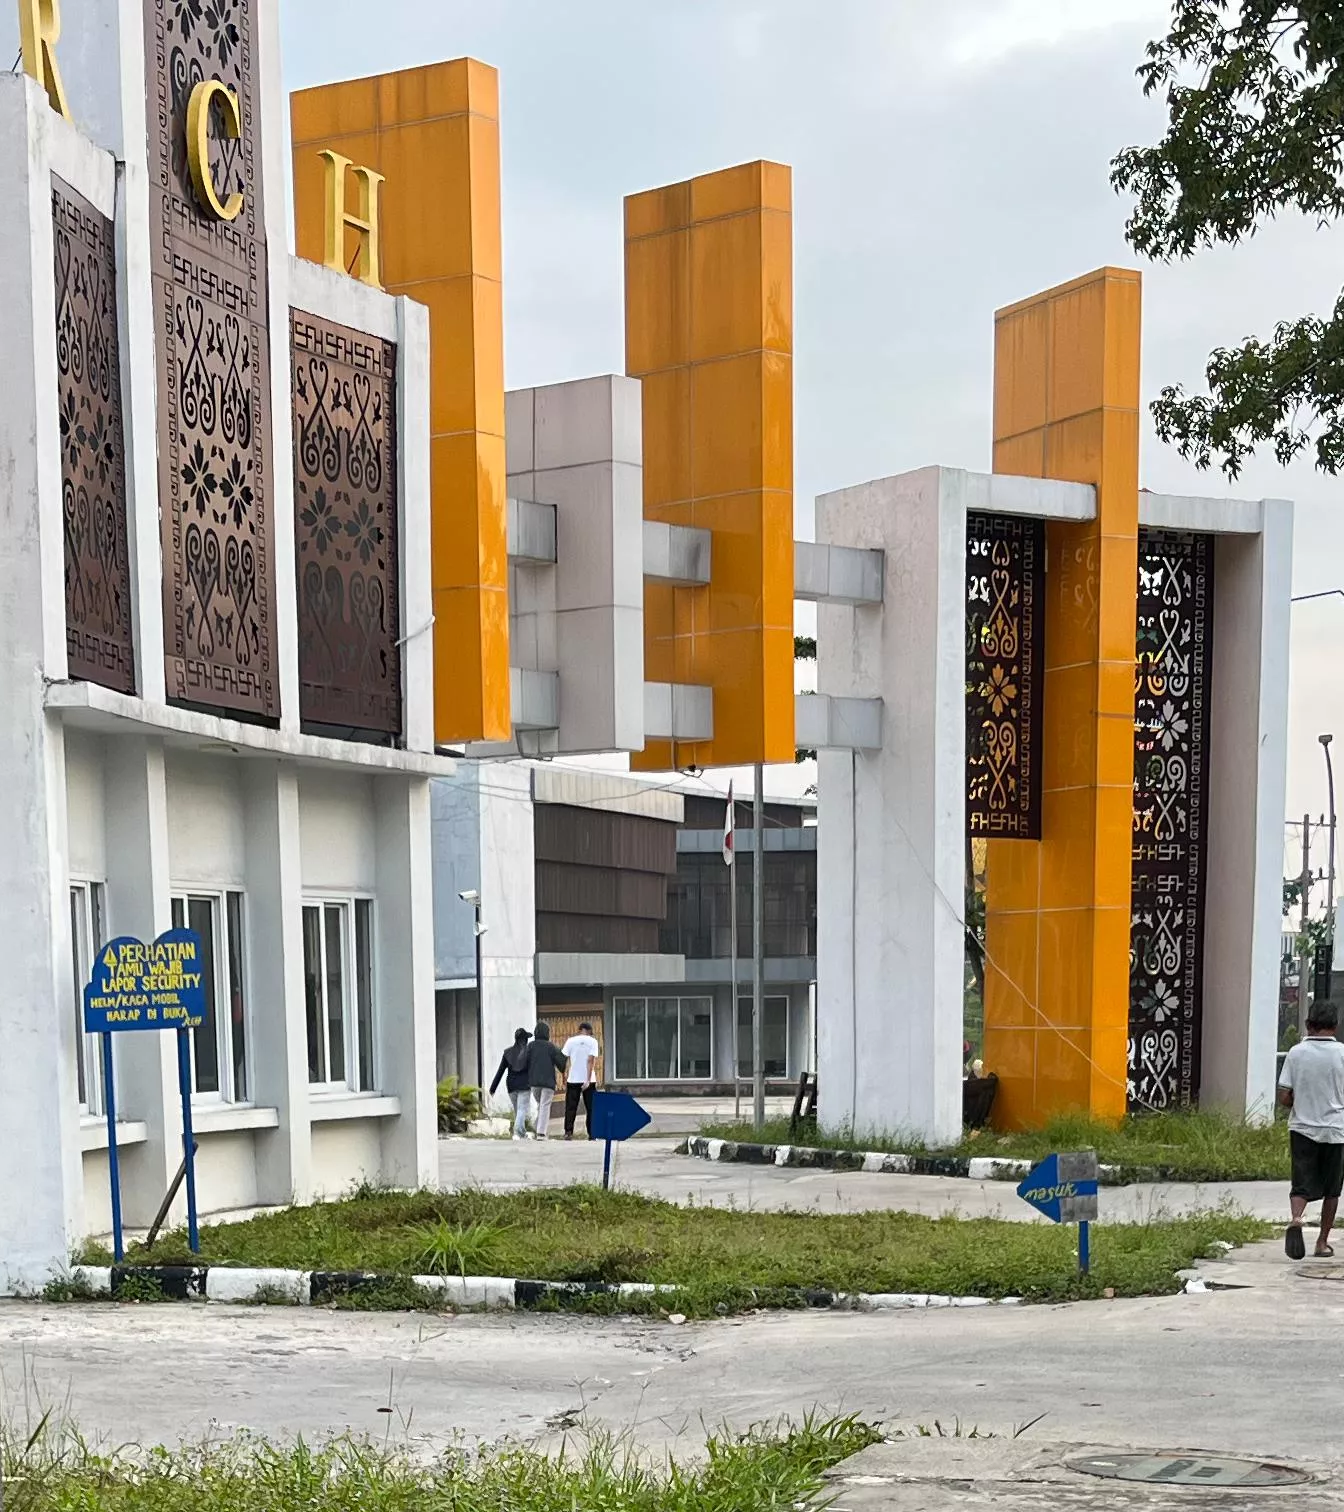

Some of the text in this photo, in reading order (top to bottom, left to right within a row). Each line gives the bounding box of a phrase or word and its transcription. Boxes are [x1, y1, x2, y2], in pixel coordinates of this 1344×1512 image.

[118, 942, 196, 962] PERHATIAN
[107, 960, 184, 977] TAMU WAJIB
[102, 973, 201, 993] LAPOR SECURITY
[106, 1009, 141, 1022] HARAP
[163, 1006, 189, 1019] BUKA
